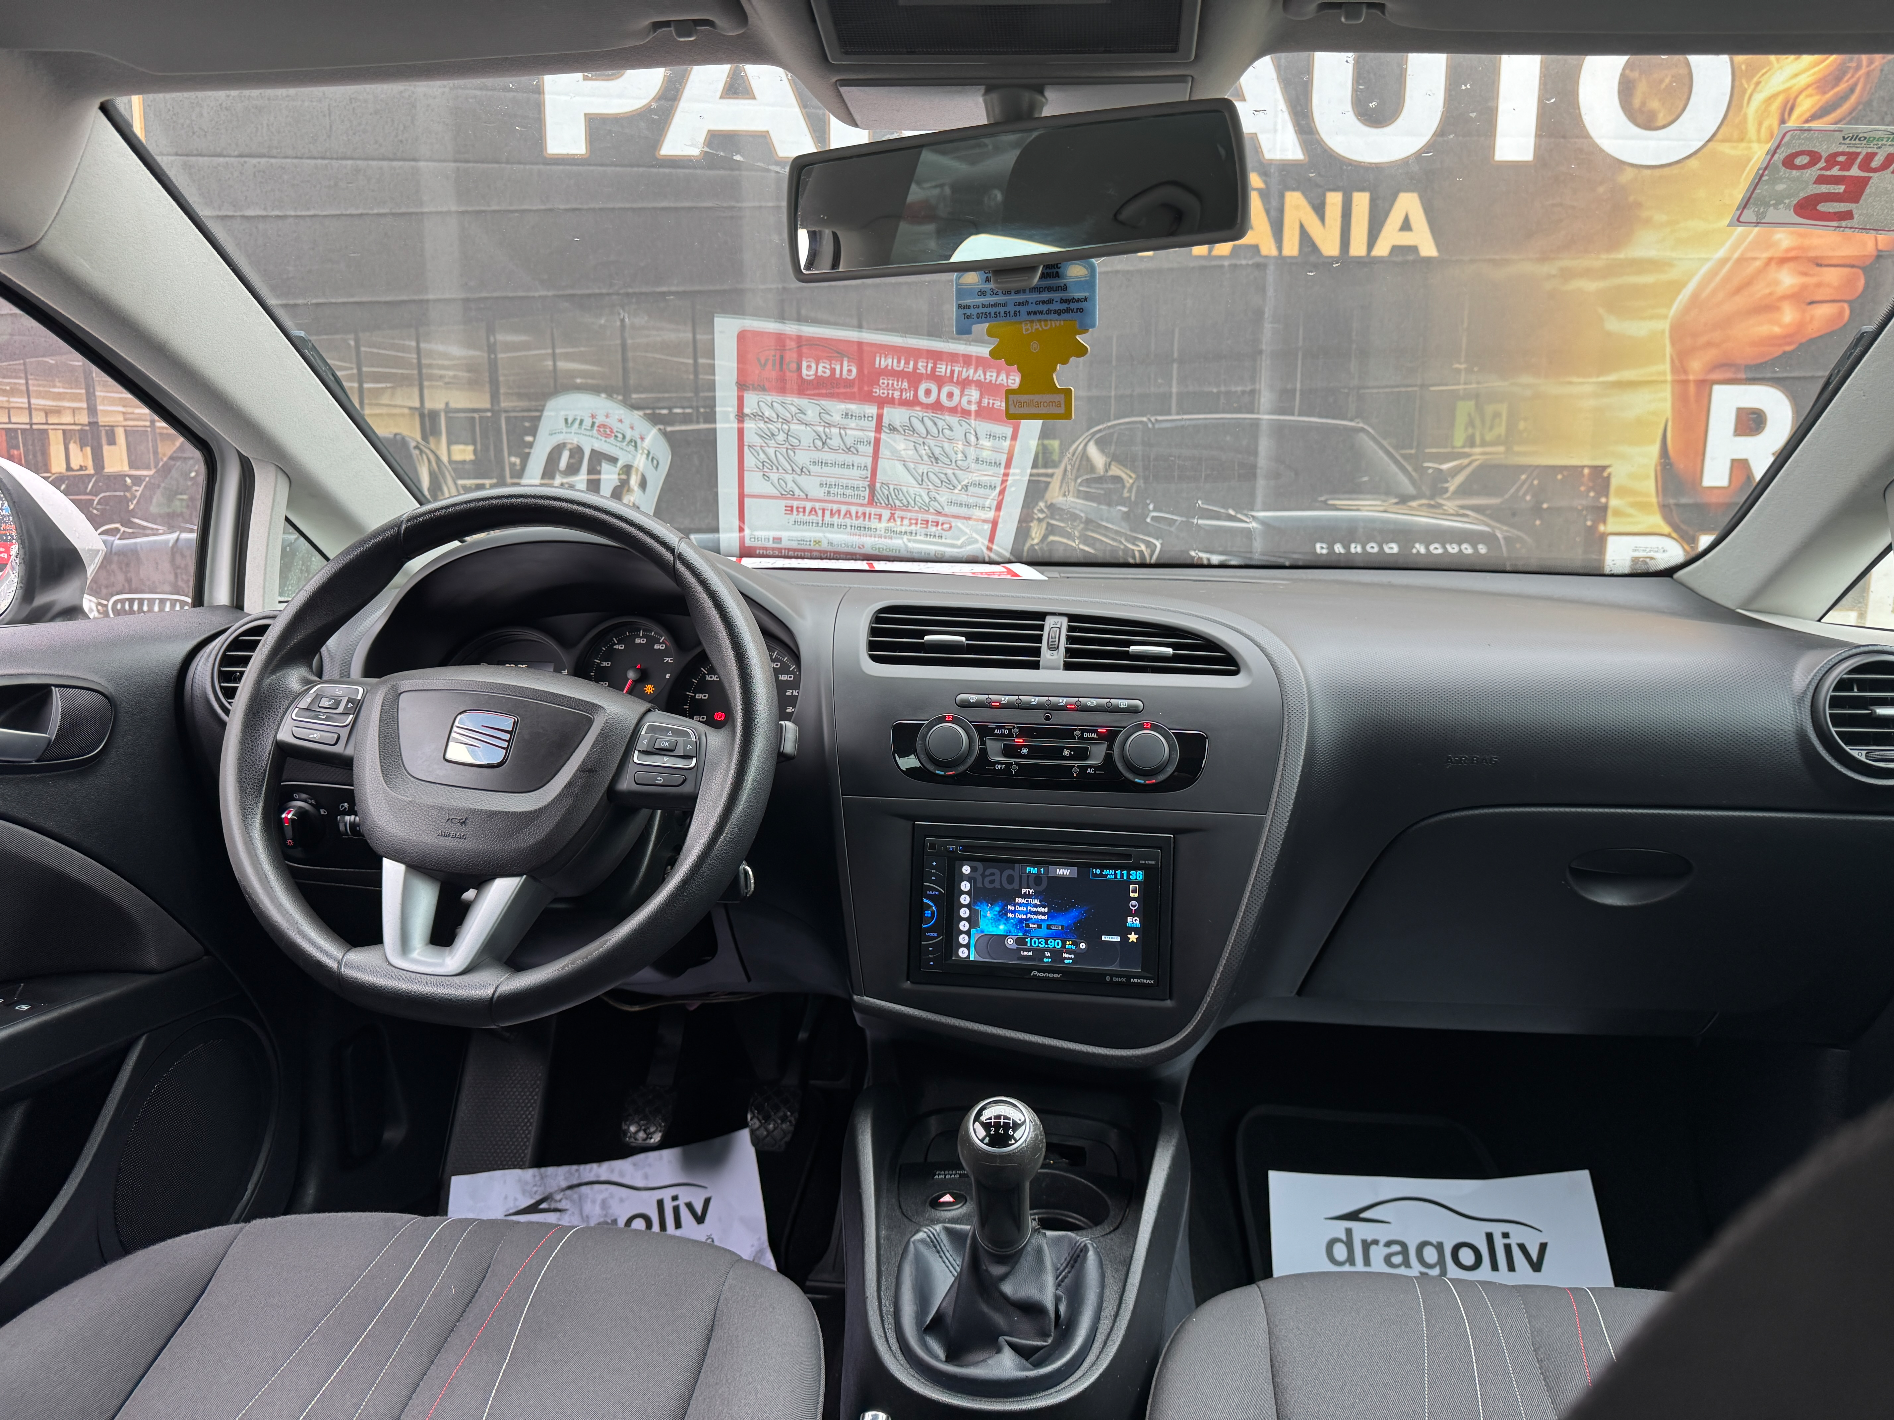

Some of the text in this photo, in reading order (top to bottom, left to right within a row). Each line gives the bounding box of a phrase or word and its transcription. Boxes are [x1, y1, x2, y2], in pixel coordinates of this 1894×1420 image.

[540, 64, 882, 158] PA
[1203, 172, 1440, 257] ÂNIA
[1042, 262, 1061, 270] ARC
[1039, 271, 1060, 279] ANIA
[990, 288, 1000, 296] 32
[963, 306, 1084, 320] Tel: 0751.51.51.61 www.dragoliv.ro
[1012, 397, 1062, 408] Vanillaroma
[963, 862, 1048, 891] Radio
[1026, 938, 1062, 949] 103.90
[594, 1194, 713, 1232] oliv
[1325, 1227, 1549, 1278] dragoliv
